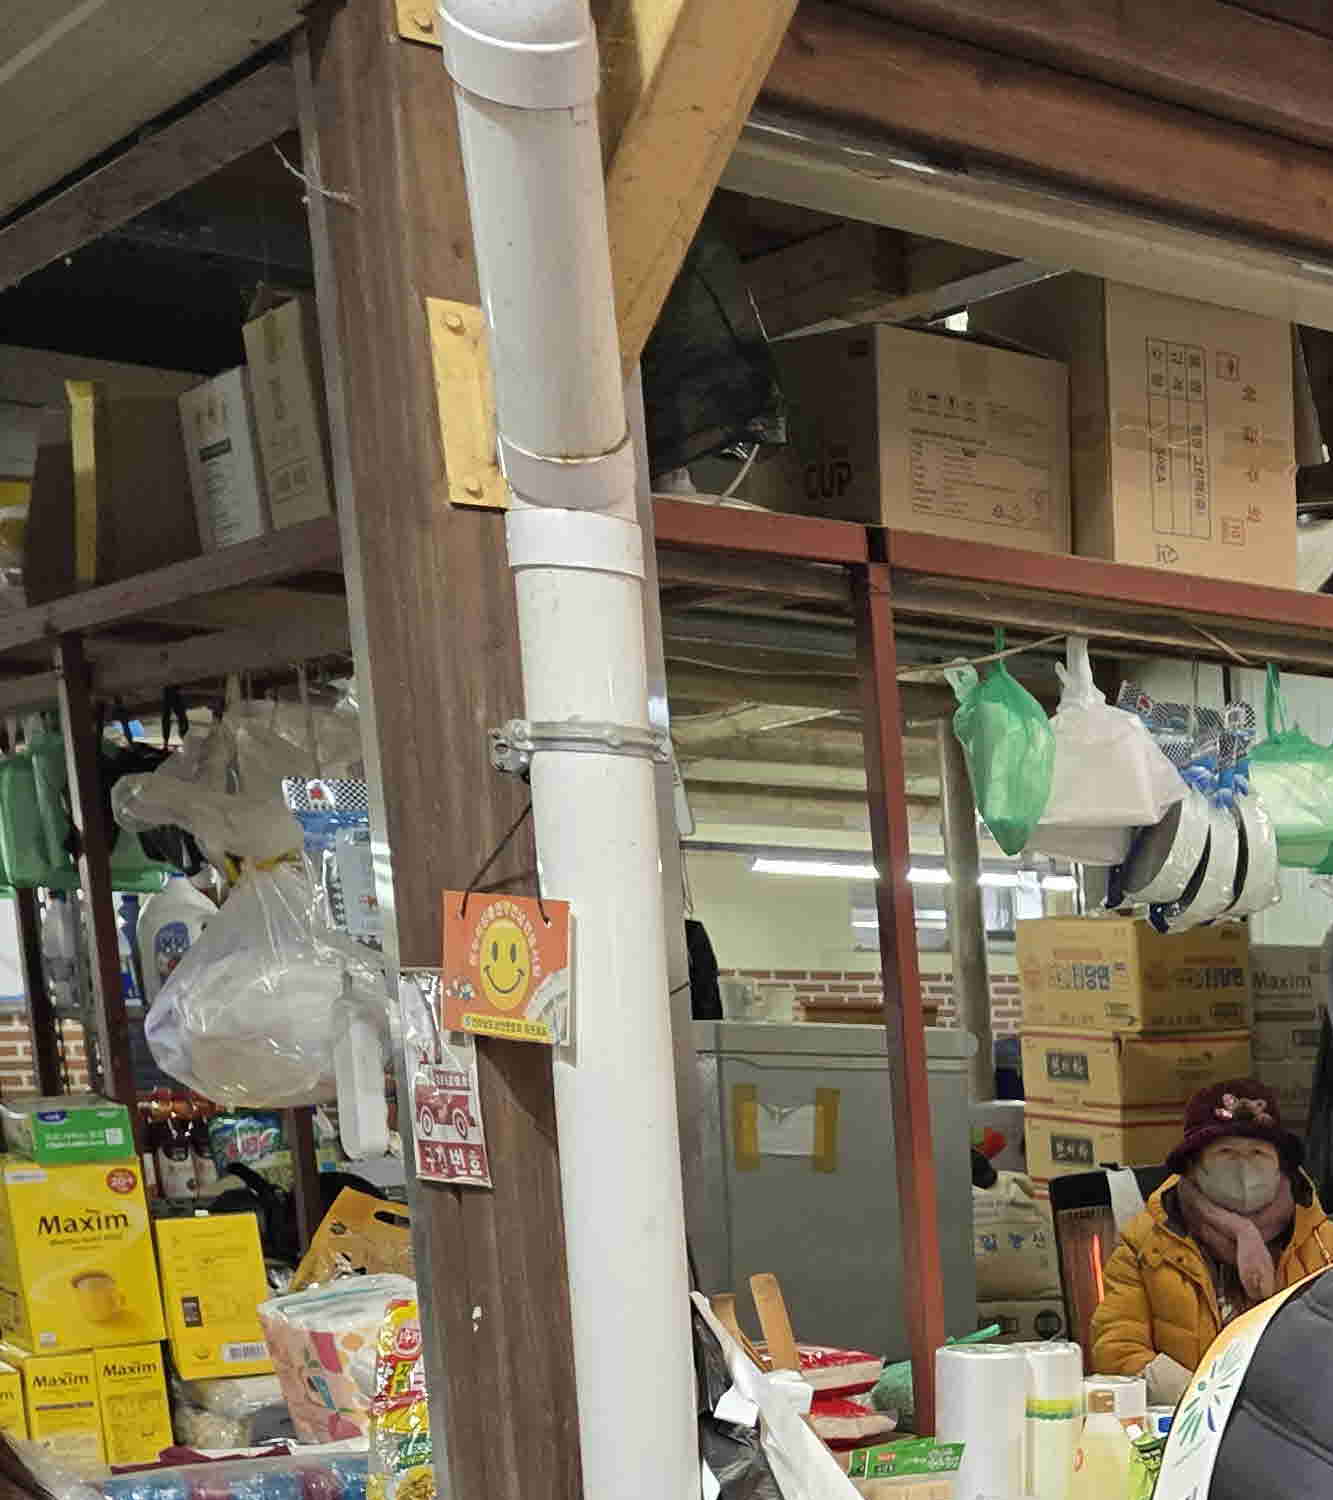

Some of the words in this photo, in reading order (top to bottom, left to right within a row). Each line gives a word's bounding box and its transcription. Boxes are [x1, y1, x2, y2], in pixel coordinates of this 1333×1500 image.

[1252, 971, 1312, 990] Maxim
[37, 1209, 130, 1237] Maxim
[103, 1360, 158, 1378] Maxim
[32, 1372, 90, 1388] Maxim
